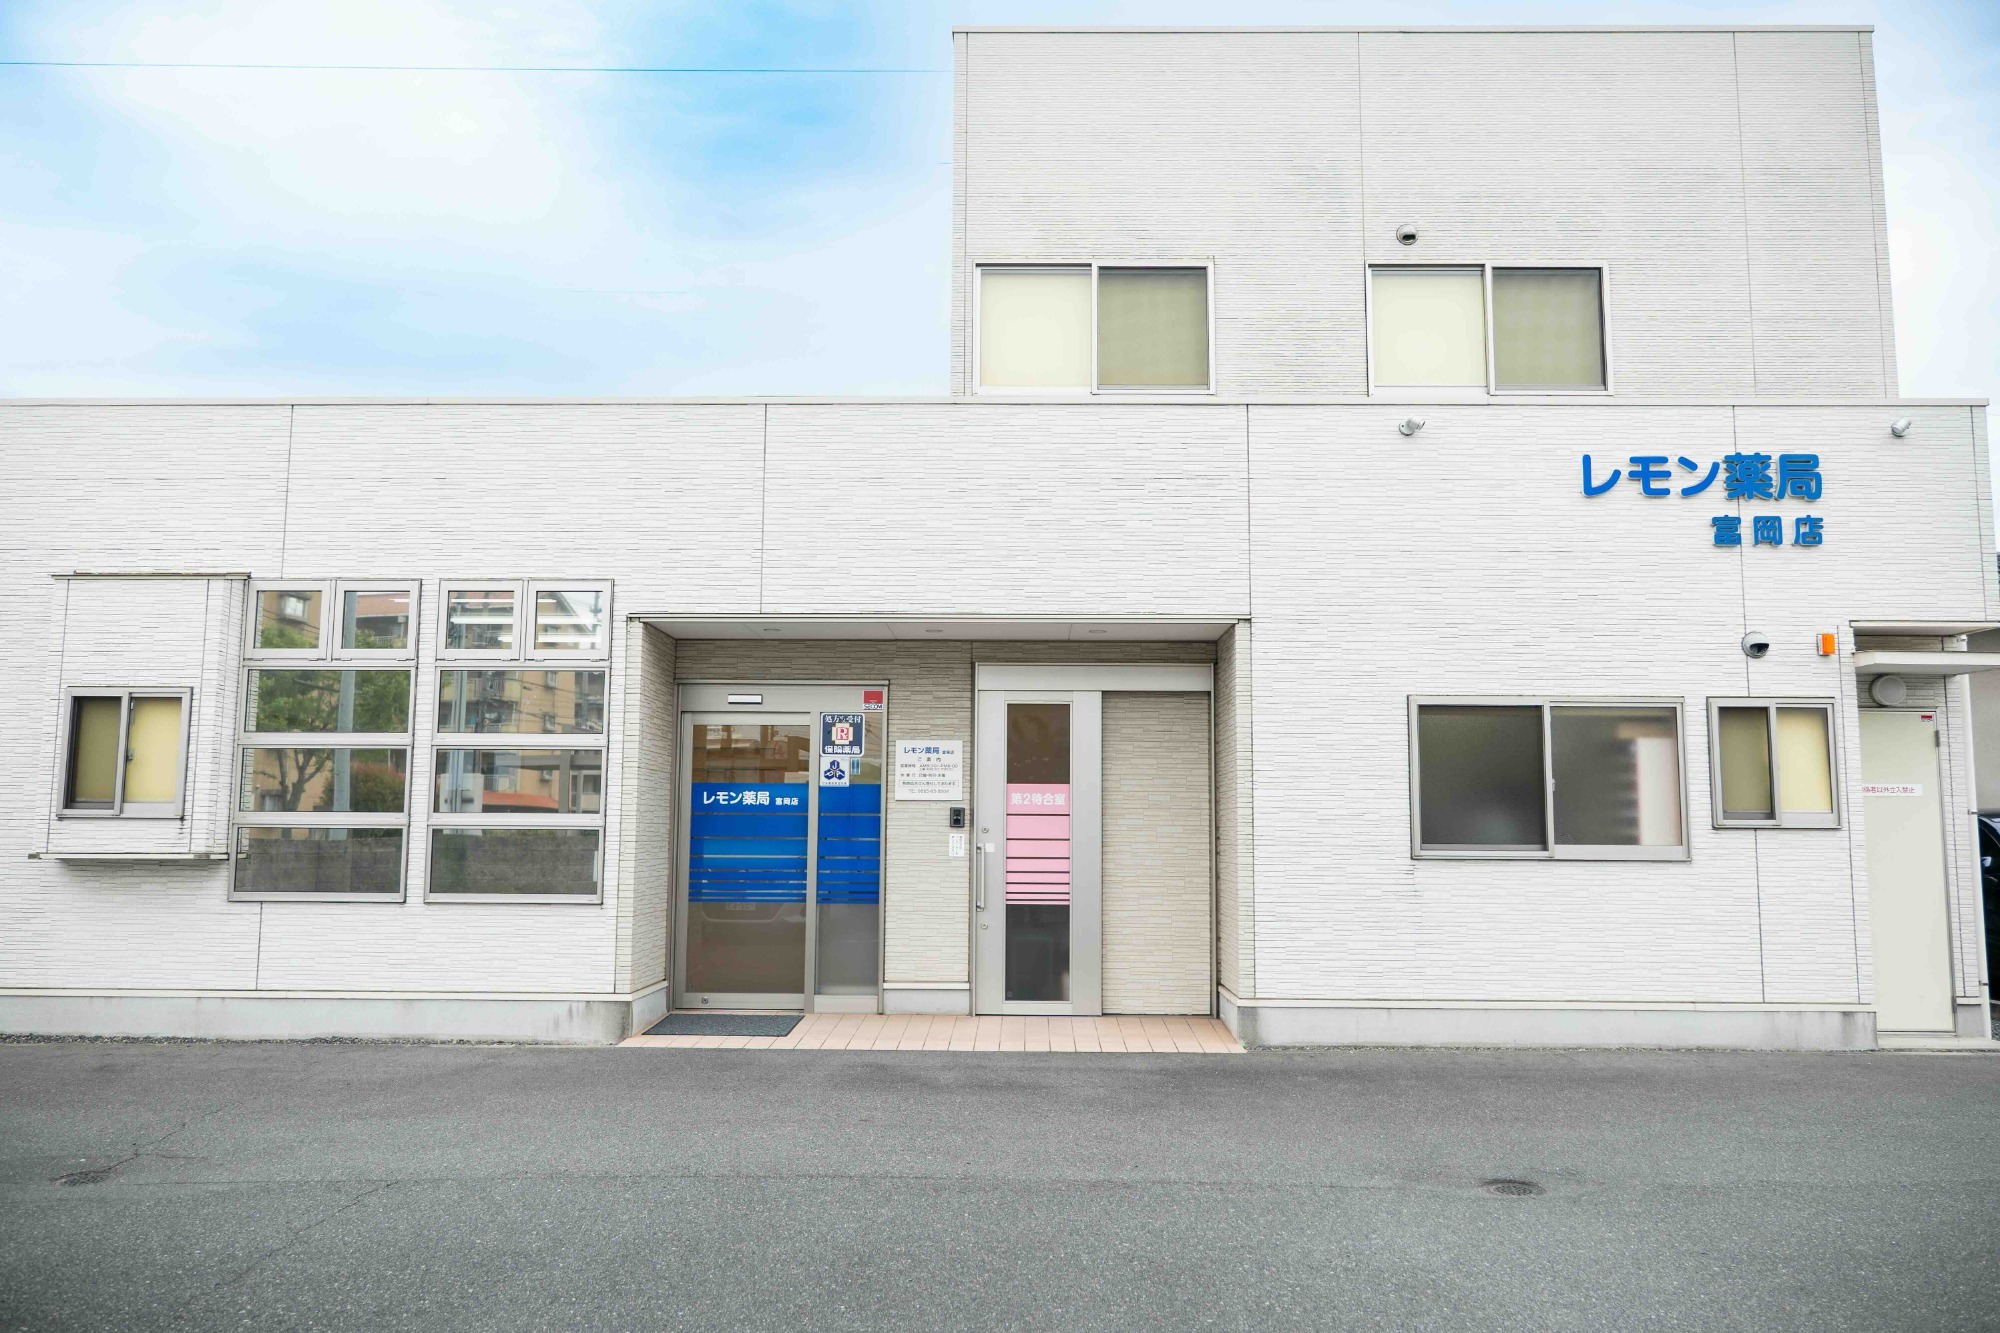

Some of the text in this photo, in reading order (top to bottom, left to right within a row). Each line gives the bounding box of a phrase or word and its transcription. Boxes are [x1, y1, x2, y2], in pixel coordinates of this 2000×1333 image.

[1582, 452, 1823, 500] レモン薬局
[1711, 515, 1824, 546] 富岡店
[703, 790, 799, 805] レモン薬局 富岡店
[1862, 786, 1916, 794] 係者以外立入禁止
[1011, 792, 1066, 805] 第2待合室
